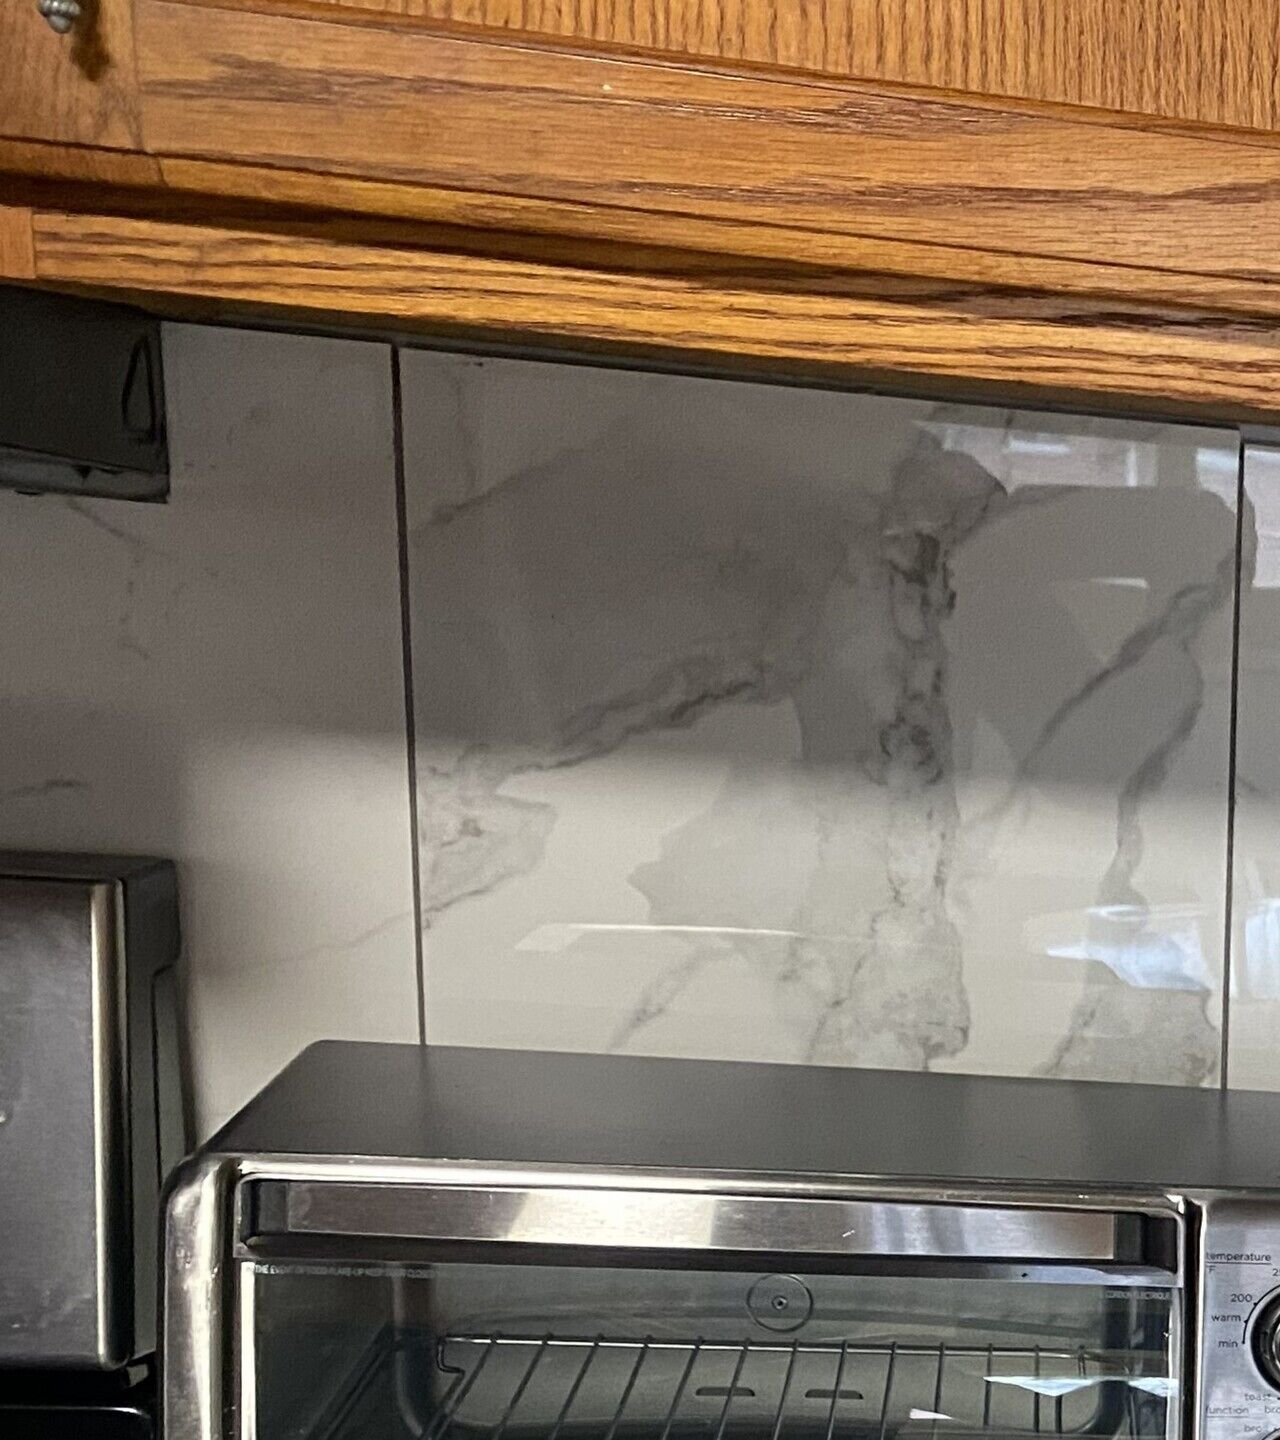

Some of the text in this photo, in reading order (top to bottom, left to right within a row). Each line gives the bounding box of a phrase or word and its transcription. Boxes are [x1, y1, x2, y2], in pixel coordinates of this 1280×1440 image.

[1205, 1251, 1272, 1264] temperature
[1230, 1293, 1253, 1303] 200
[1211, 1314, 1242, 1323] warm
[1218, 1339, 1239, 1348] min
[1205, 1405, 1250, 1414] function
